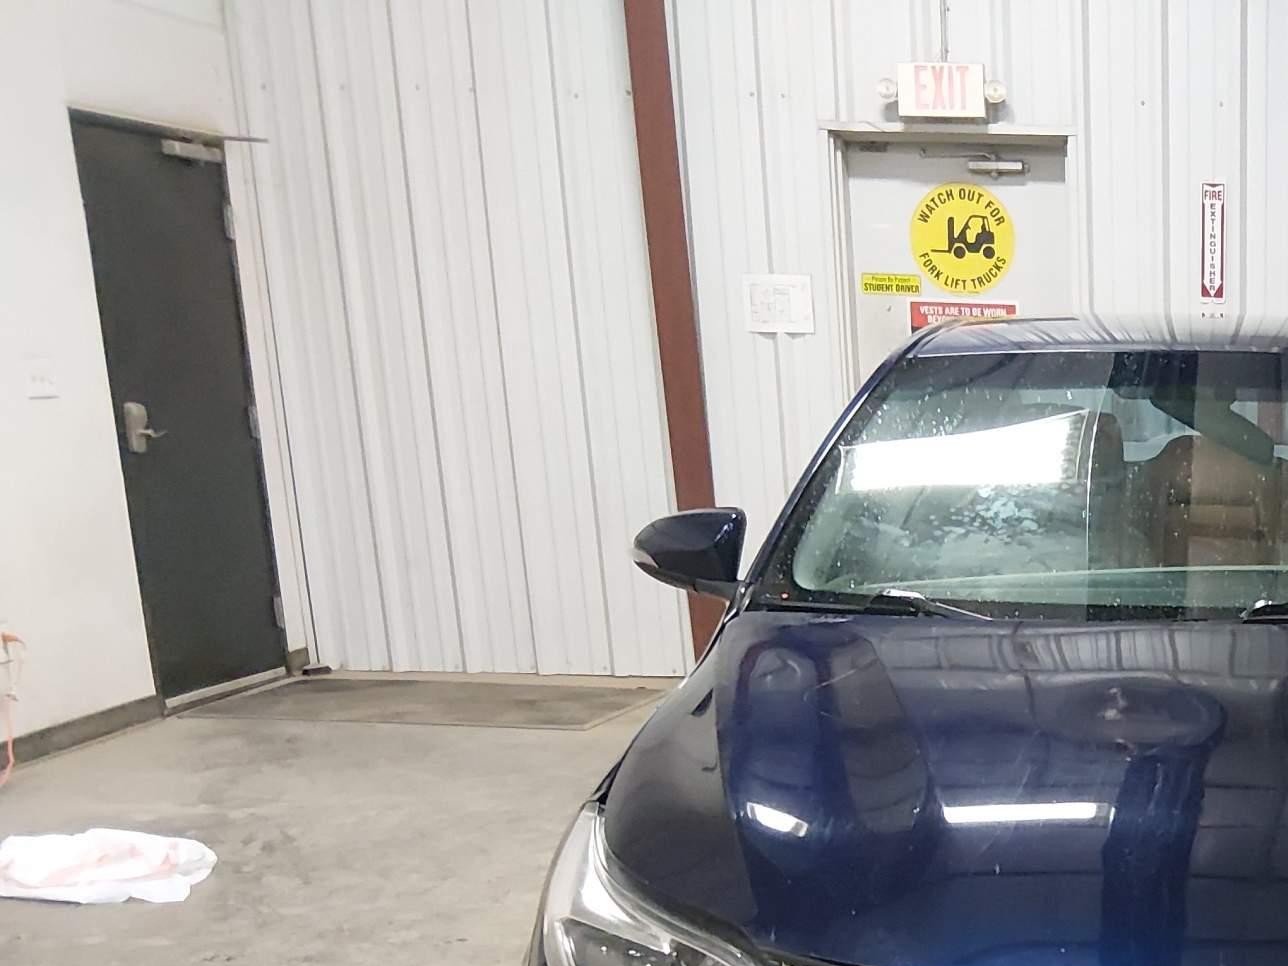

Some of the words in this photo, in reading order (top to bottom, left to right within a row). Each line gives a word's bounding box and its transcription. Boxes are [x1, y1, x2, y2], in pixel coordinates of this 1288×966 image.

[914, 65, 970, 111] EXIT
[918, 188, 955, 223] WATCH
[958, 188, 985, 205] OUT
[984, 200, 1006, 226] FOR
[1204, 190, 1223, 201] FIRE
[919, 252, 943, 281] FORK
[944, 275, 967, 290] LIFT
[970, 256, 1007, 289] TRUCKS
[864, 283, 894, 292] STUDENT
[896, 284, 920, 293] DRIVER
[920, 306, 943, 315] VESTS
[945, 307, 960, 316] ARE
[960, 307, 971, 316] TO
[972, 308, 982, 317] BE
[983, 308, 1007, 318] WORN
